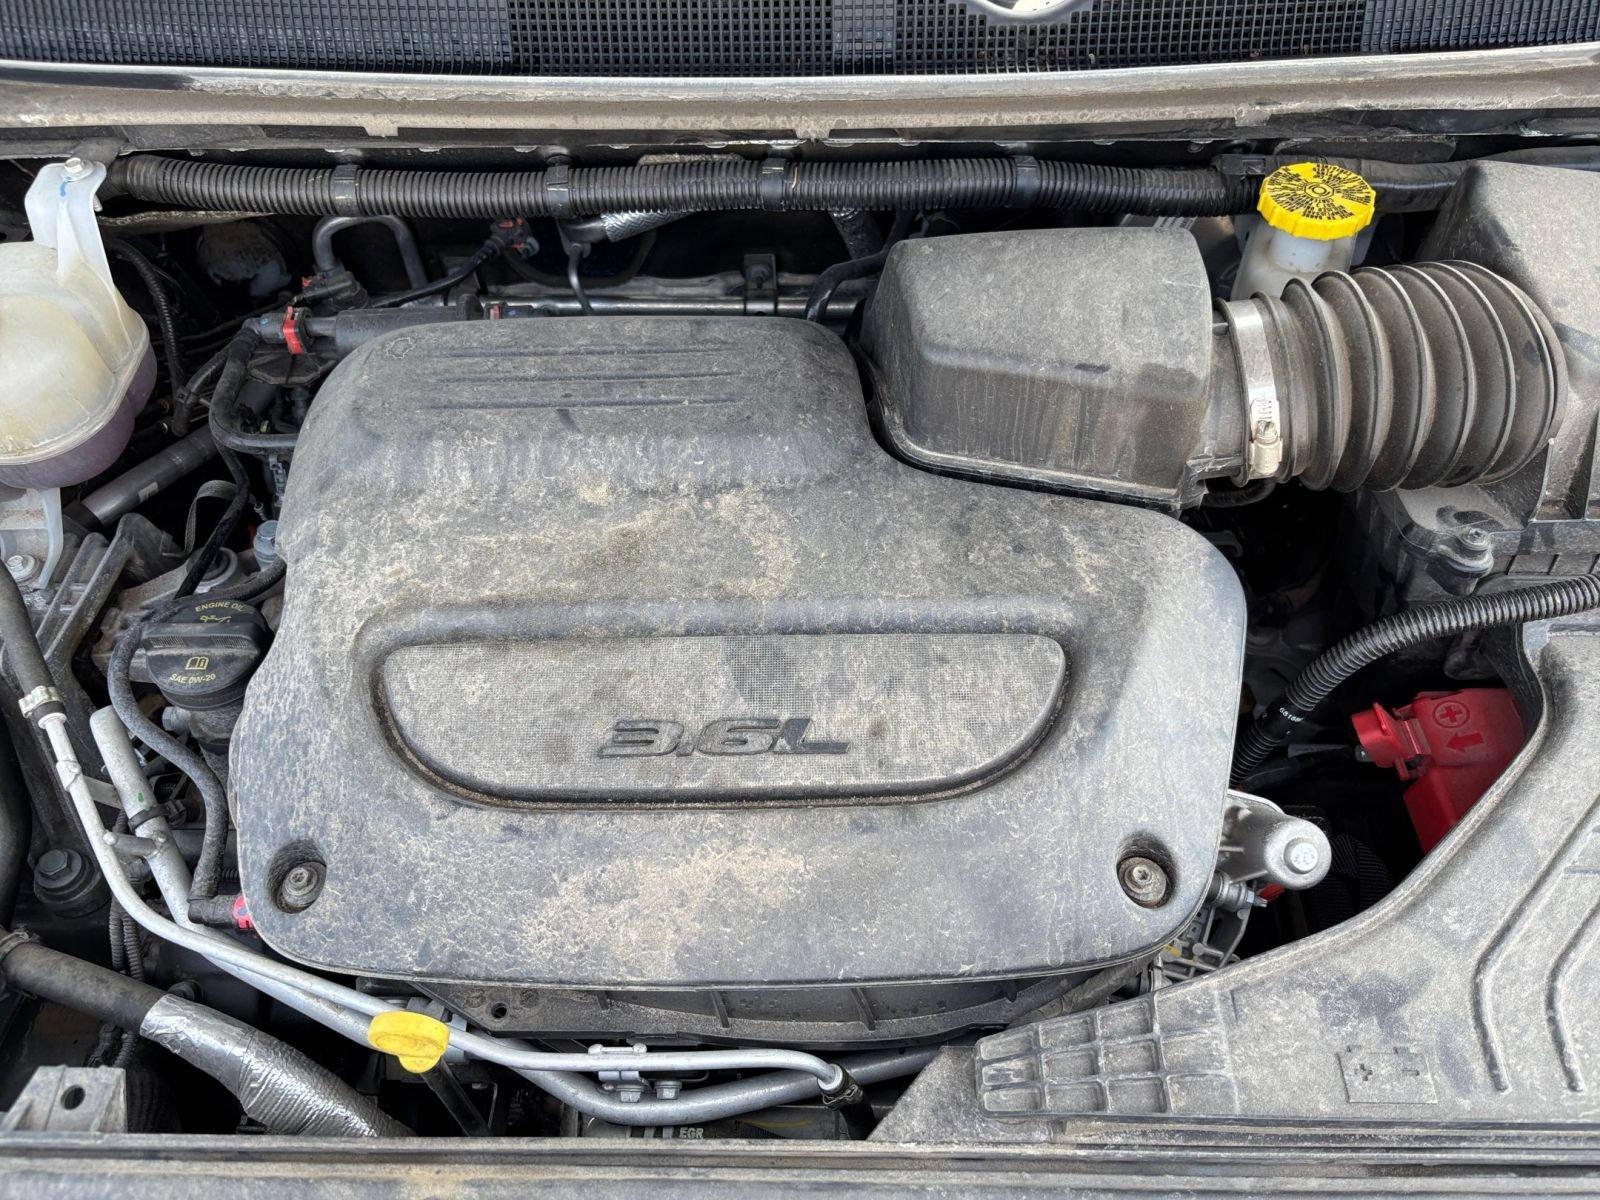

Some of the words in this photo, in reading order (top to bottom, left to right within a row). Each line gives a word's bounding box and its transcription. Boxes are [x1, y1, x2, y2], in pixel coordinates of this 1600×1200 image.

[195, 601, 230, 613] ENGINE
[231, 601, 244, 612] OIL
[169, 673, 188, 684] SAE
[189, 673, 216, 684] 0W-20
[597, 718, 851, 759] 3.6L
[679, 1127, 704, 1139] EGR
